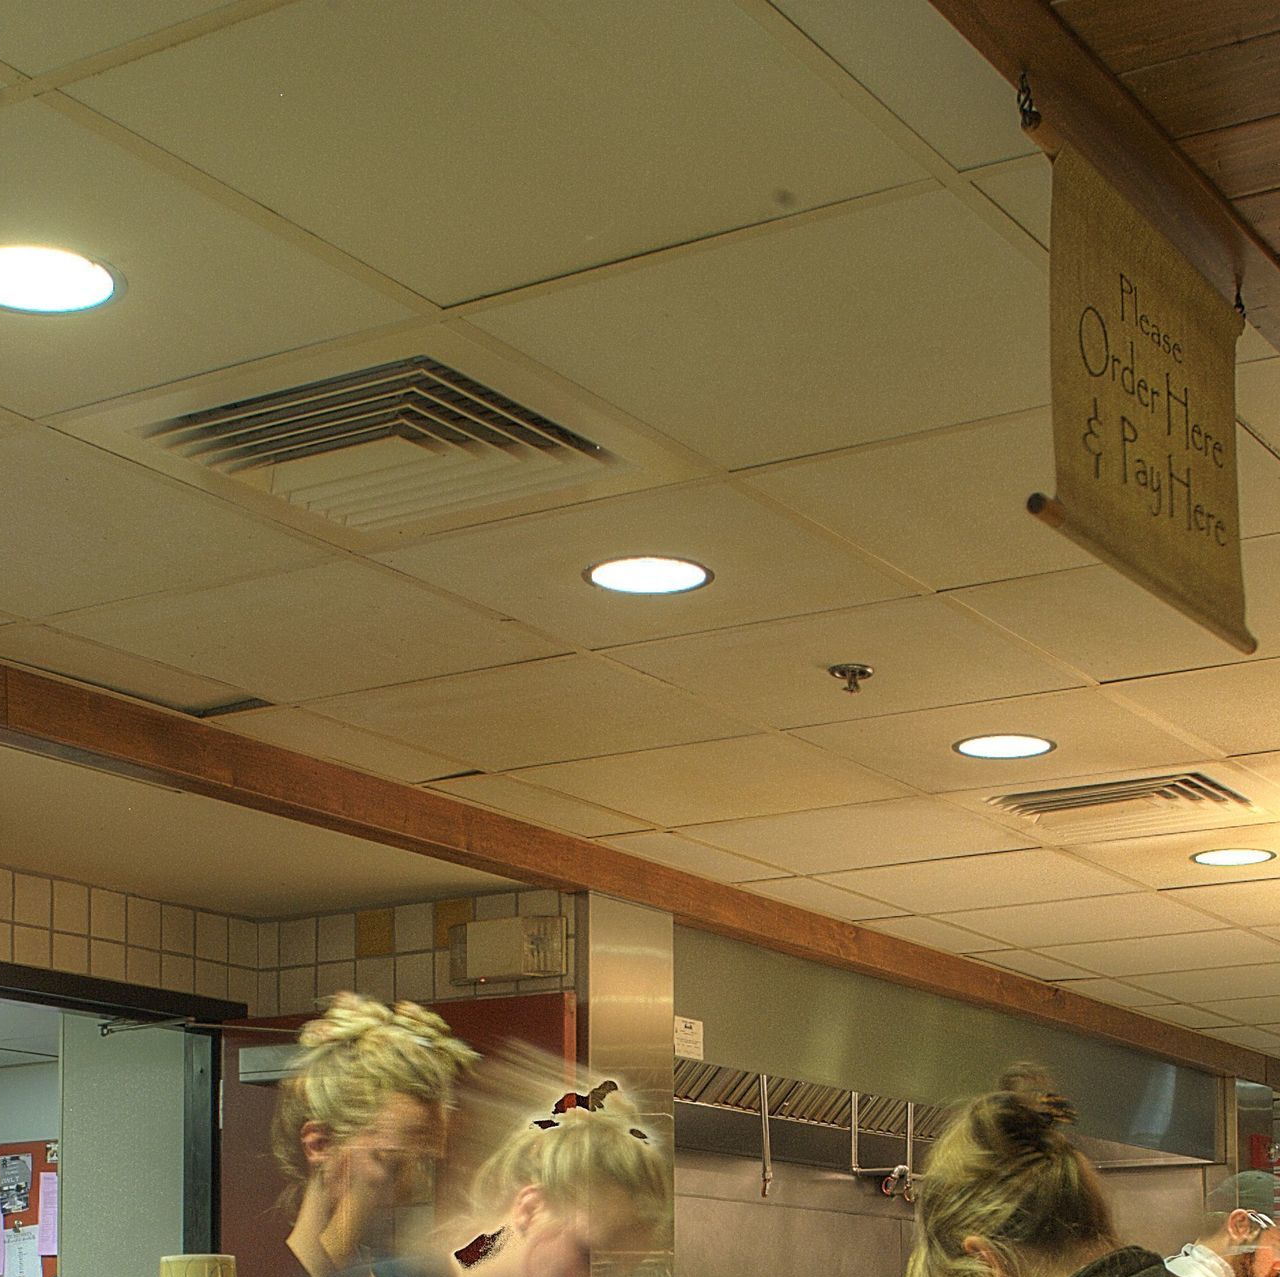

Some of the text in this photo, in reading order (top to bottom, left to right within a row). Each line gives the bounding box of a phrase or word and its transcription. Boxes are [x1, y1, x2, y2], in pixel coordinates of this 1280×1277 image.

[1118, 272, 1183, 364] Please
[1078, 305, 1224, 470] Order Here
[1120, 414, 1163, 517] Pay
[1167, 453, 1227, 547] Here
